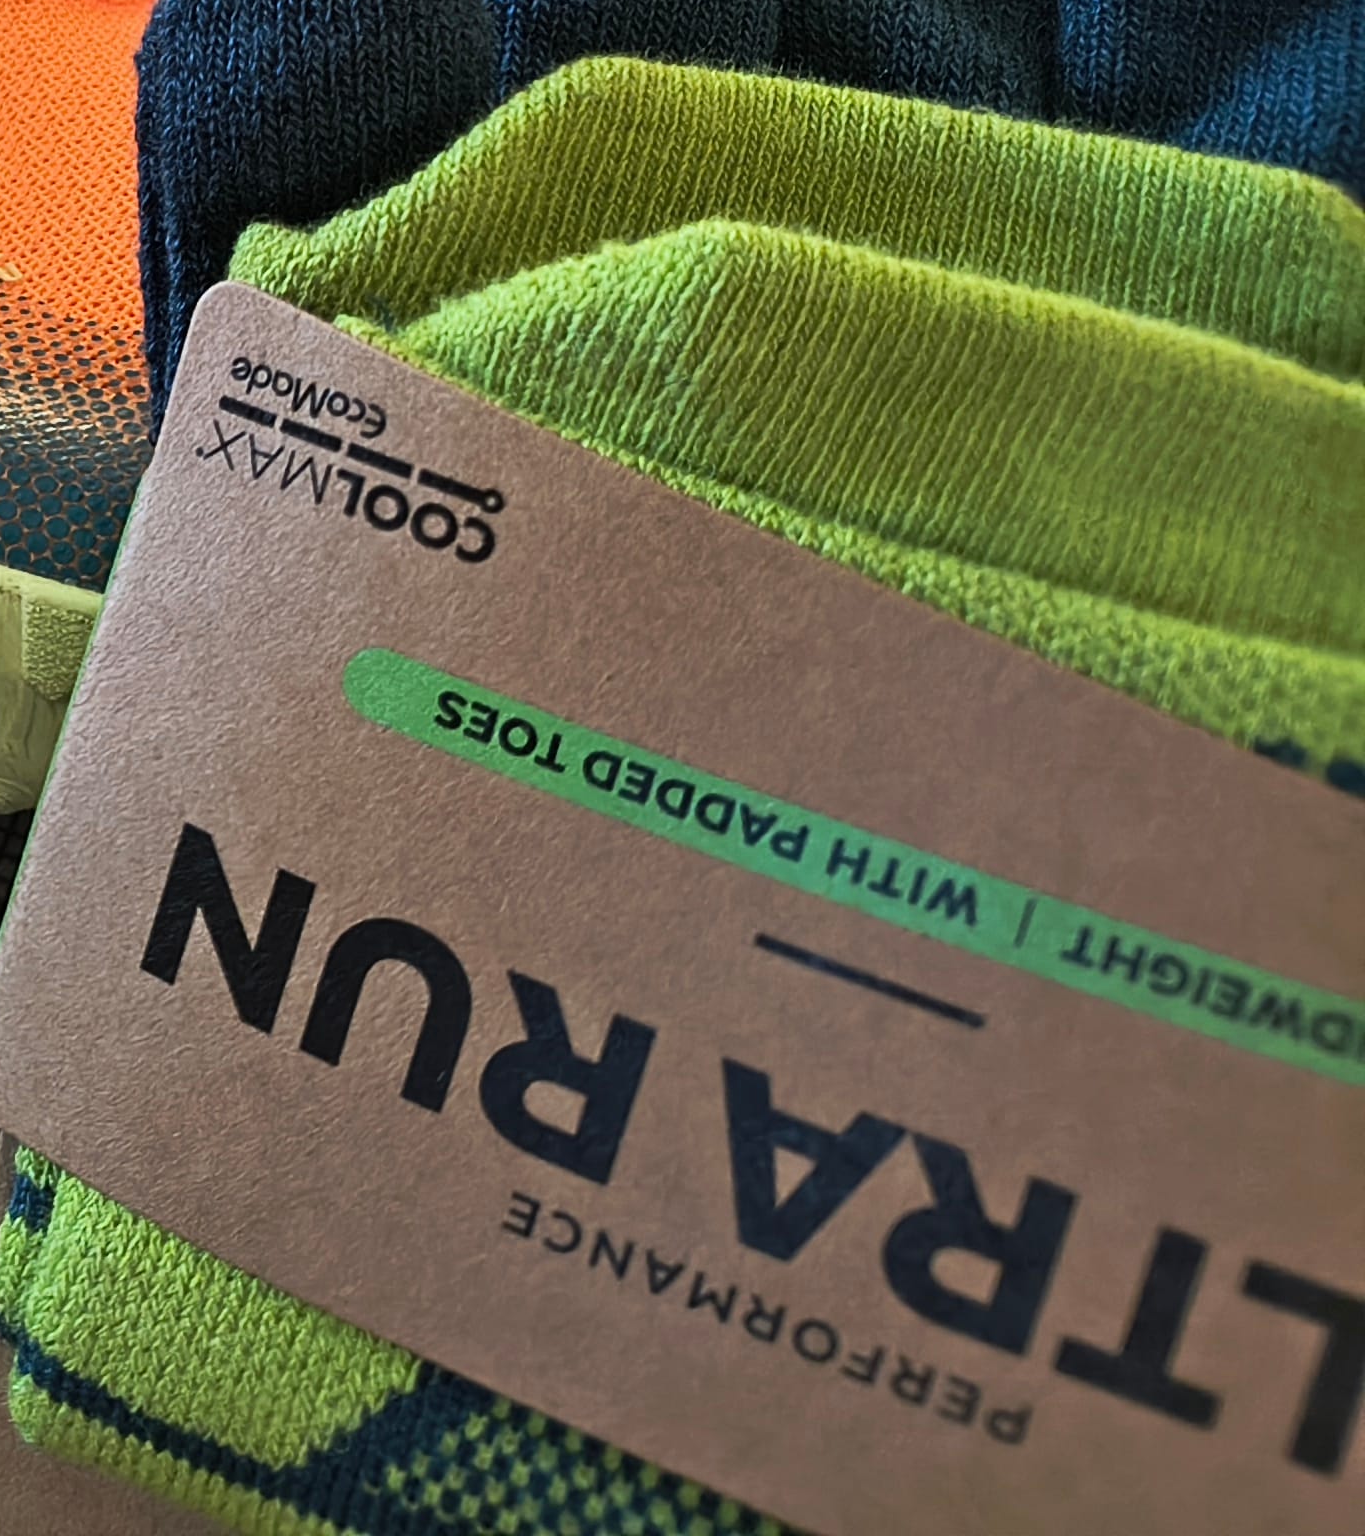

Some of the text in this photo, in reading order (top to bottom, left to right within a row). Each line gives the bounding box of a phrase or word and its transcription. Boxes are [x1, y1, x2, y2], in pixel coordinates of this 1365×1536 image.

[231, 357, 387, 439] EcoMade
[196, 419, 496, 563] COOLMAX
[433, 689, 567, 772] TOES
[582, 749, 811, 862] PADDED
[825, 836, 979, 927] WITH
[140, 820, 1365, 1478] LTRA RUN
[500, 1191, 1033, 1446] PERFORMANCE
